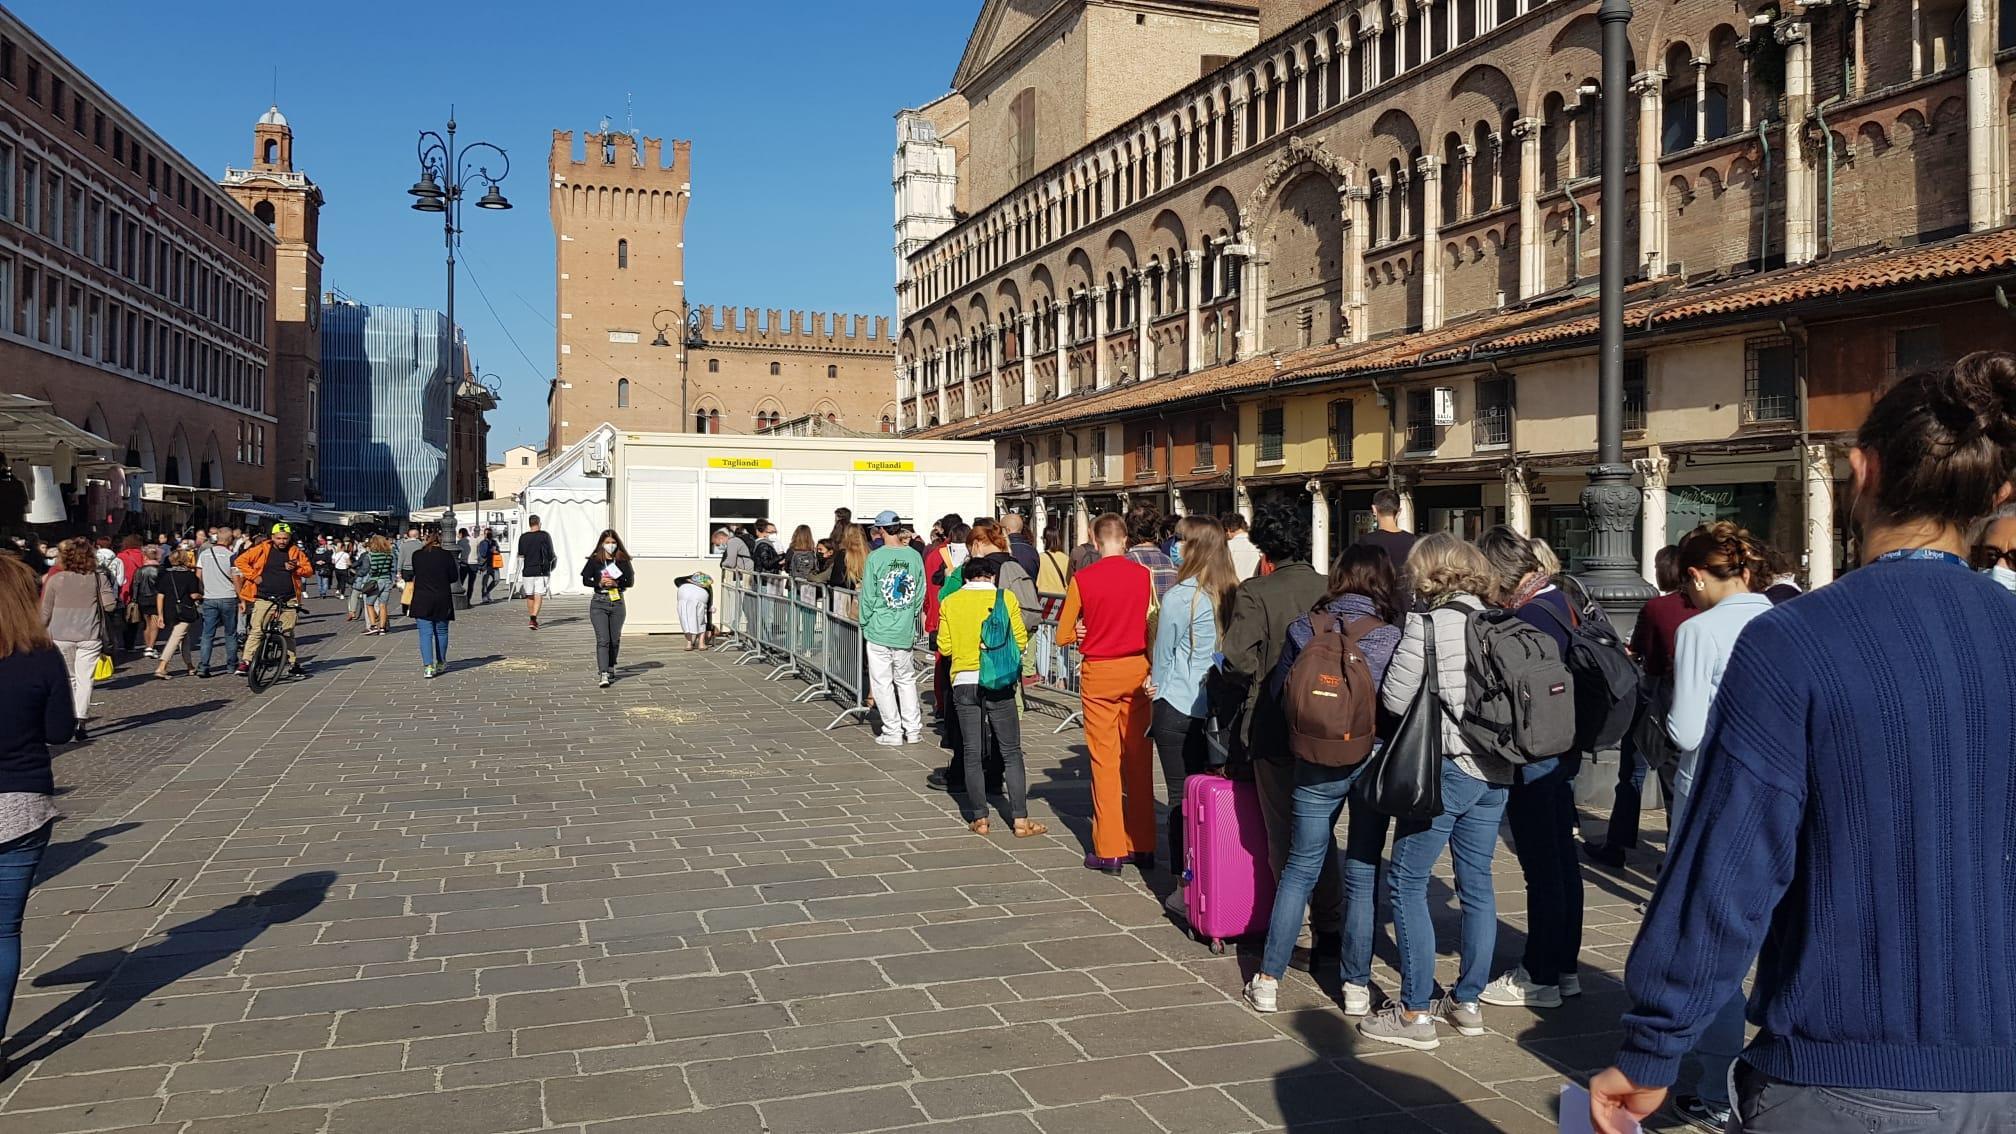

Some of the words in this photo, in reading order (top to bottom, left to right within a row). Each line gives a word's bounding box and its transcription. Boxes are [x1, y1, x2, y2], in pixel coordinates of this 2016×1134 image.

[722, 459, 759, 468] Tagliandi
[866, 461, 901, 471] Tagliandi
[1924, 549, 1944, 559] Unipol
